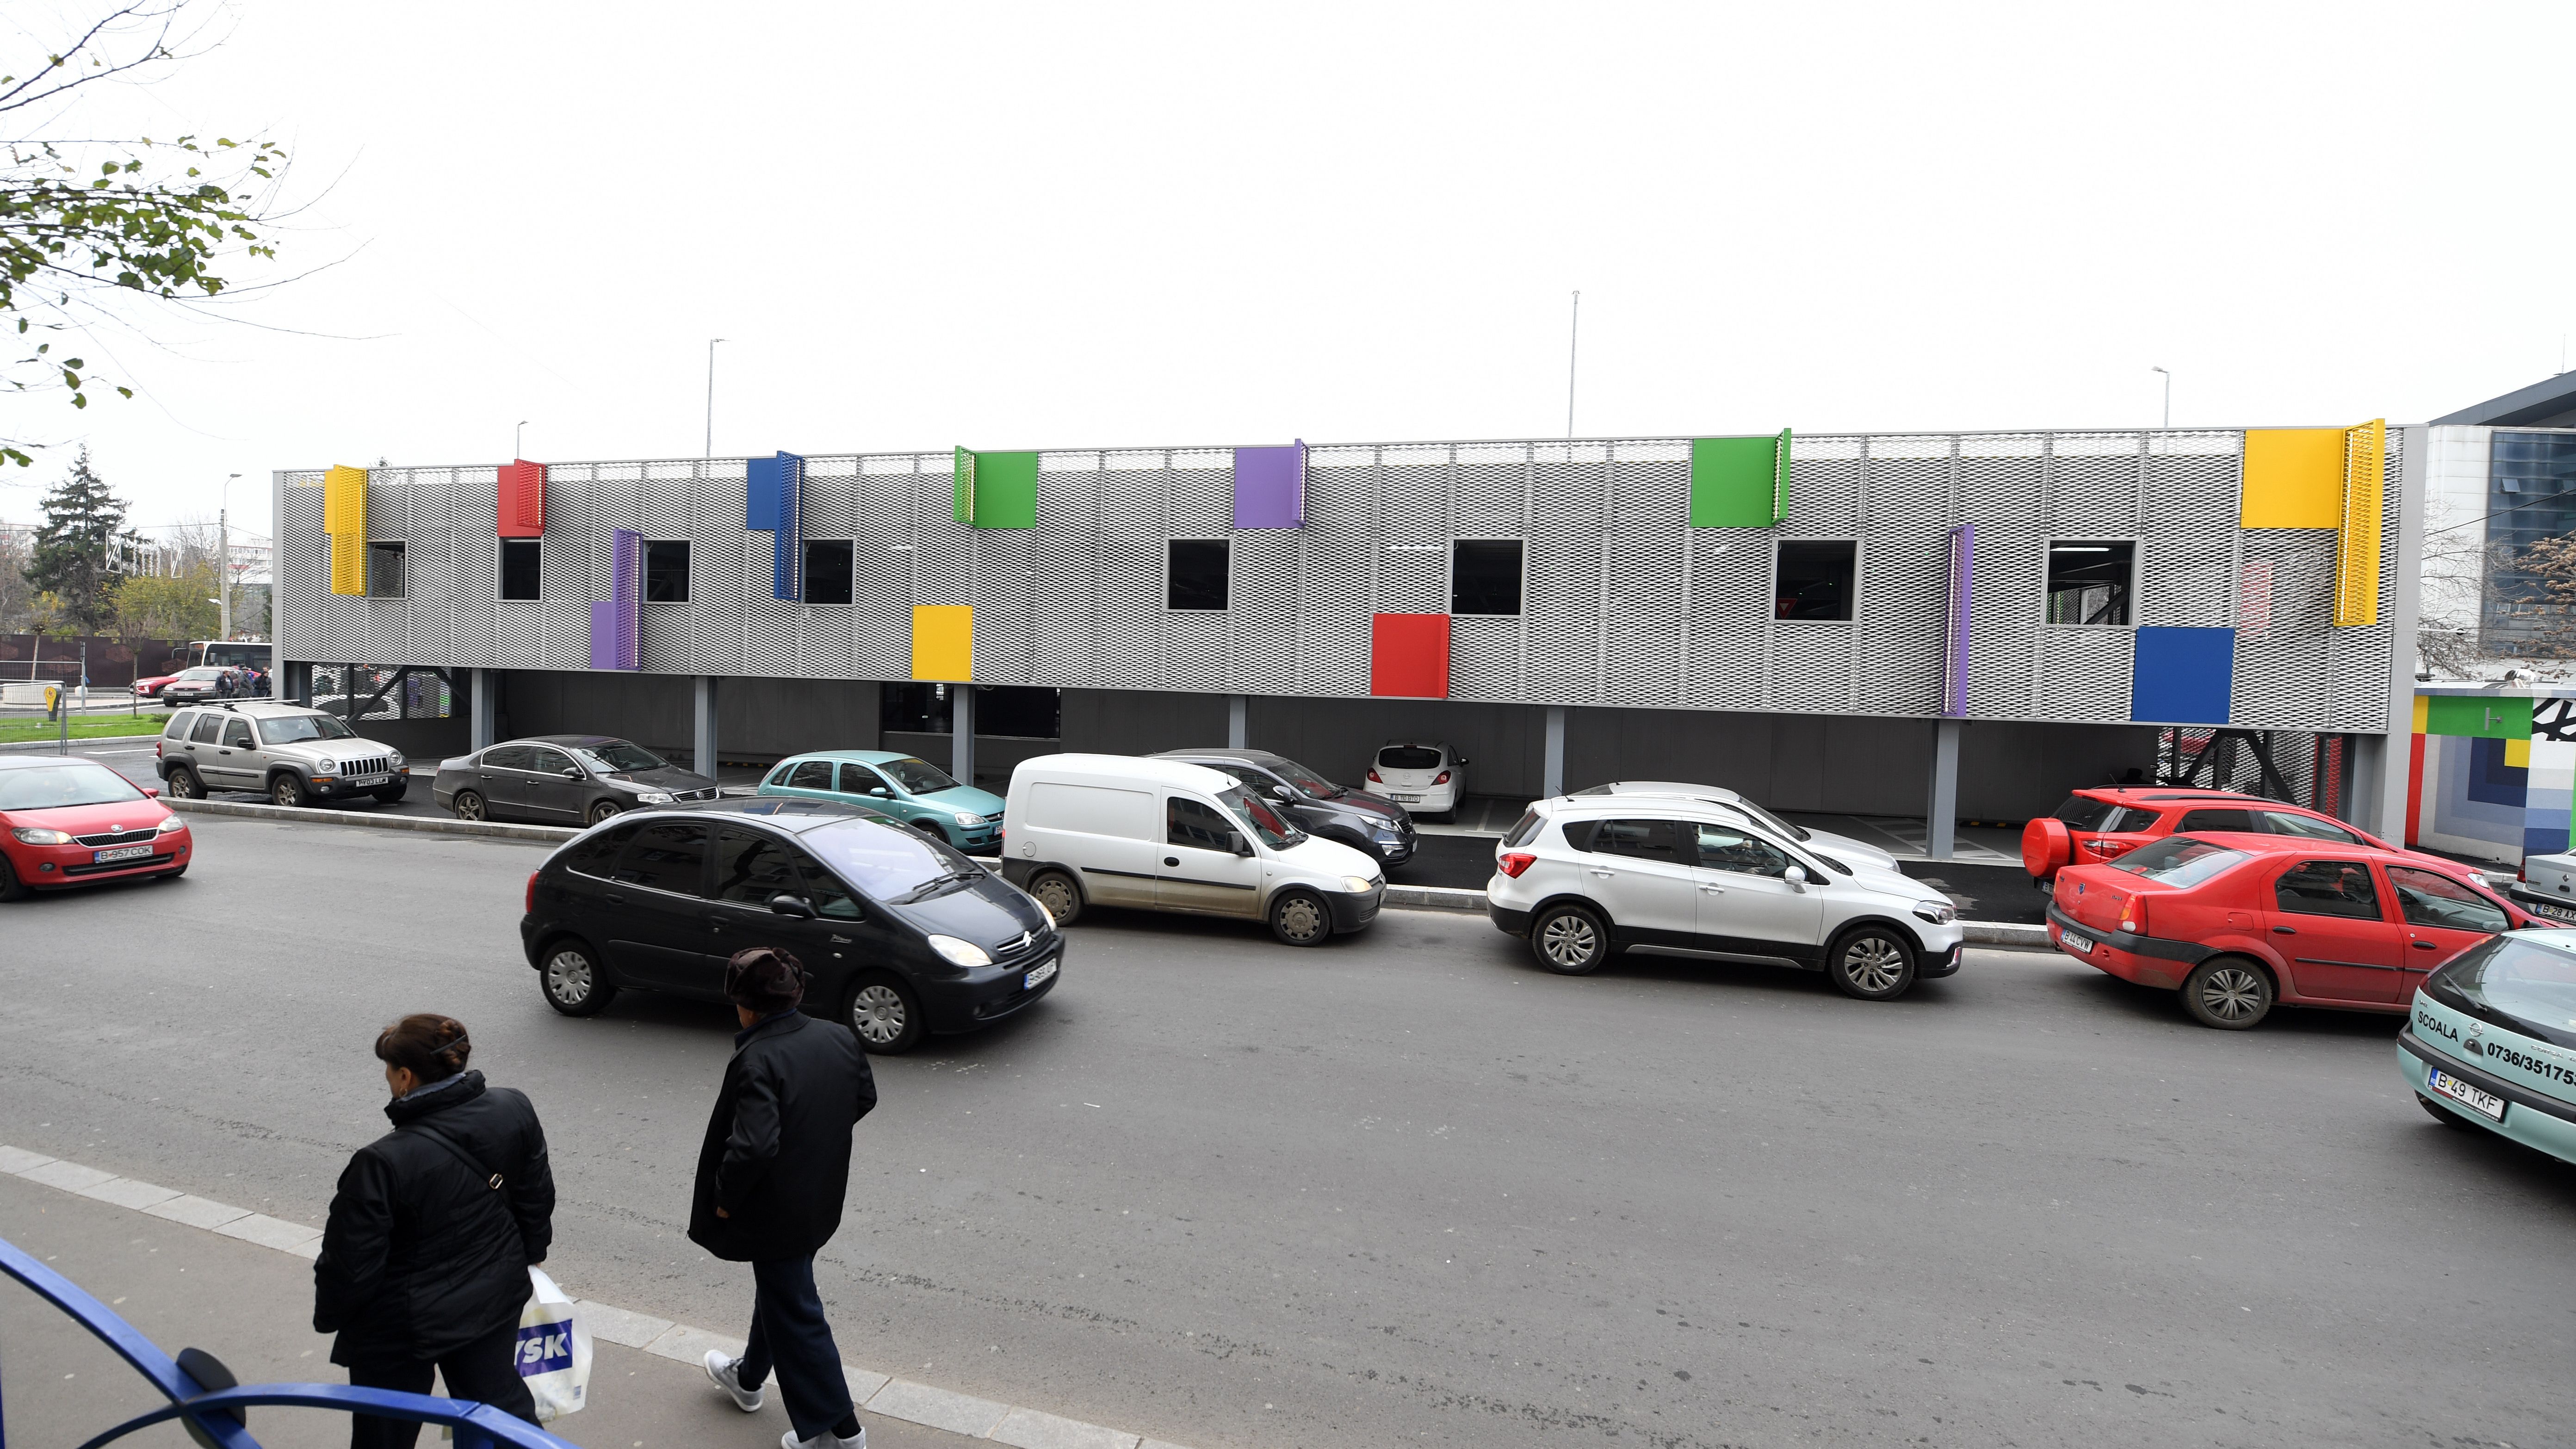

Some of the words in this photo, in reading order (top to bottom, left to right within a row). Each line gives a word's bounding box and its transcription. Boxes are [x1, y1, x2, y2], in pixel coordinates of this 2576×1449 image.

[112, 849, 129, 858] 957
[131, 846, 151, 855] COK
[2551, 907, 2563, 916] 28
[2065, 931, 2070, 940] B
[2070, 934, 2076, 943] 44
[2076, 936, 2090, 949] CVW
[2418, 1010, 2458, 1042] SCOALA
[2531, 1045, 2564, 1059] CORSA
[2438, 1073, 2447, 1088] B
[2451, 1080, 2466, 1097] 49
[2472, 1088, 2498, 1109] TKF
[514, 1332, 568, 1366] YSK
